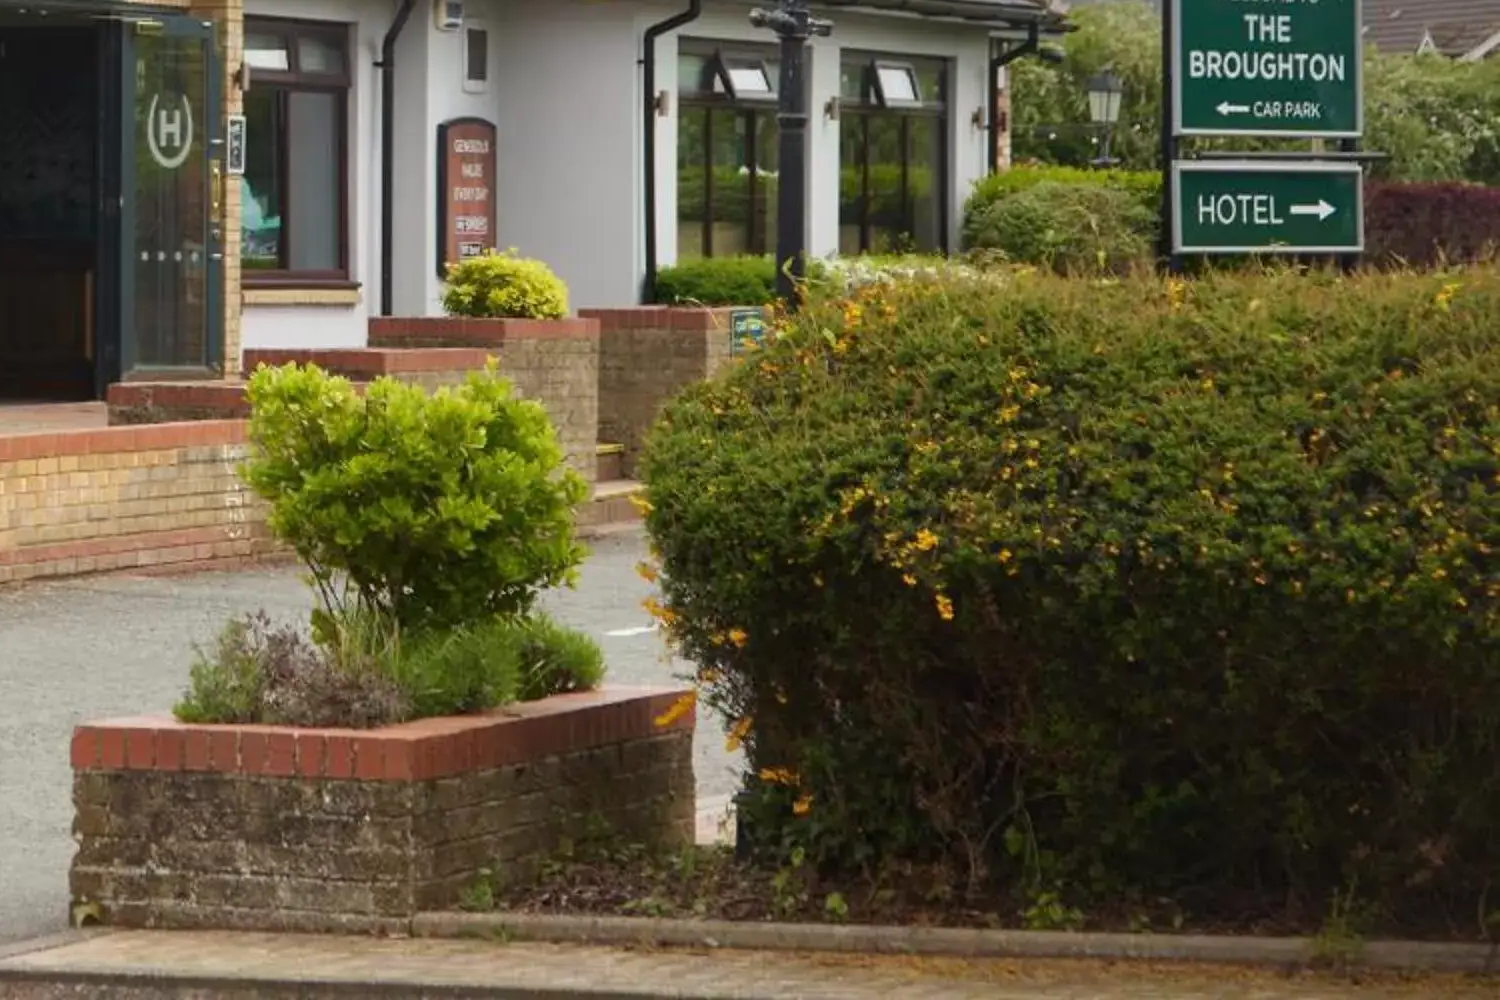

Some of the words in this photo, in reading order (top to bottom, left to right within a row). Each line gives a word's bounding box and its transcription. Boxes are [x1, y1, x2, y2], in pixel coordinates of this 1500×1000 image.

[1243, 13, 1291, 42] THE
[1189, 49, 1345, 82] BROUGHTON
[1253, 101, 1283, 118] CAR
[1285, 102, 1321, 119] PARK
[159, 109, 182, 148] H
[1198, 194, 1284, 225] HOTEL
